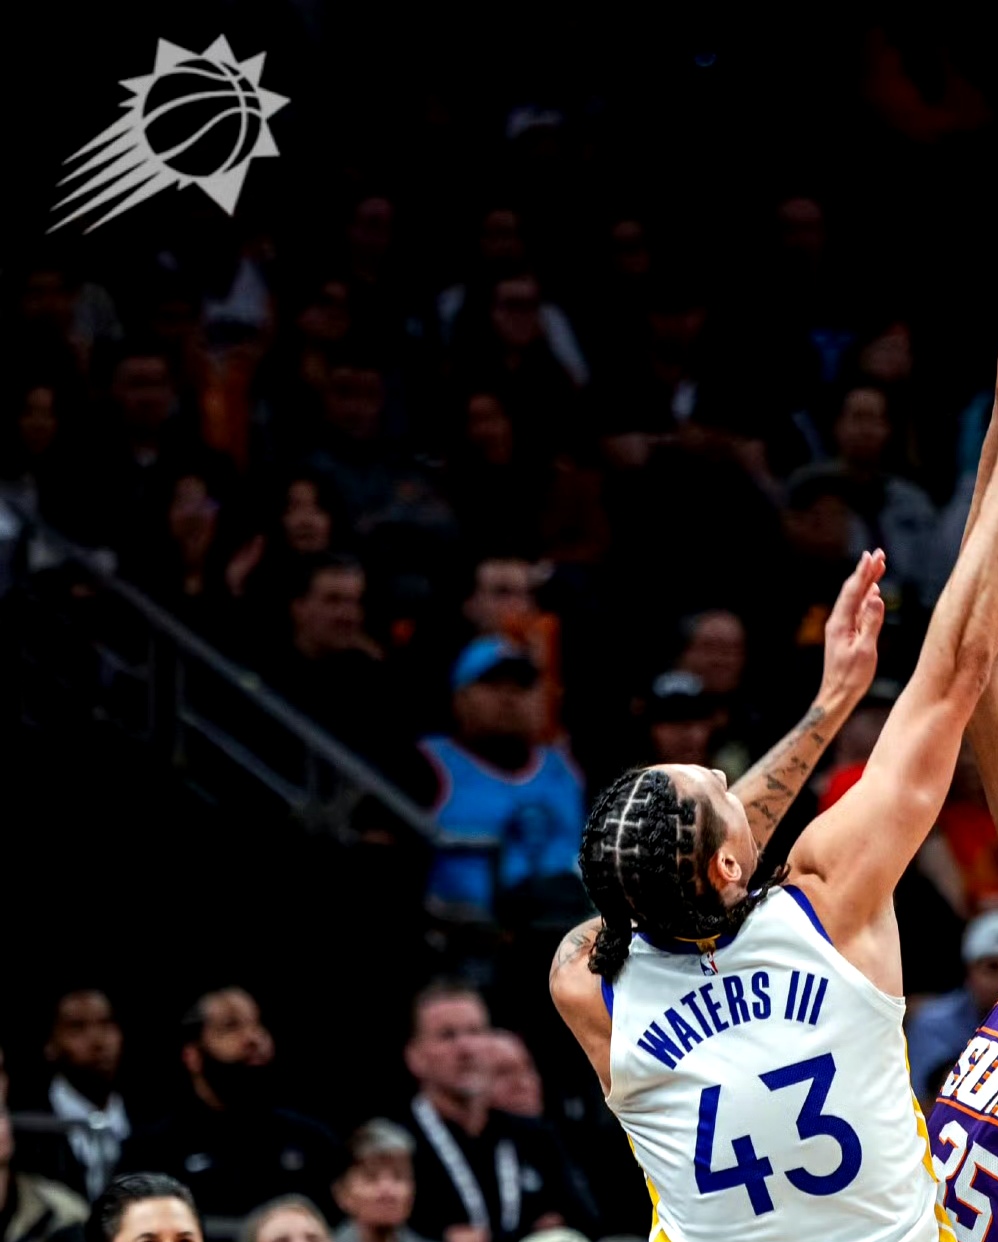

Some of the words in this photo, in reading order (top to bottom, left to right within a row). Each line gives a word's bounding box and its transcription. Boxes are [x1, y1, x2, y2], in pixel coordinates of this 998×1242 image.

[637, 971, 771, 1070] WATERS
[784, 970, 829, 1026] III
[694, 1052, 862, 1216] 43
